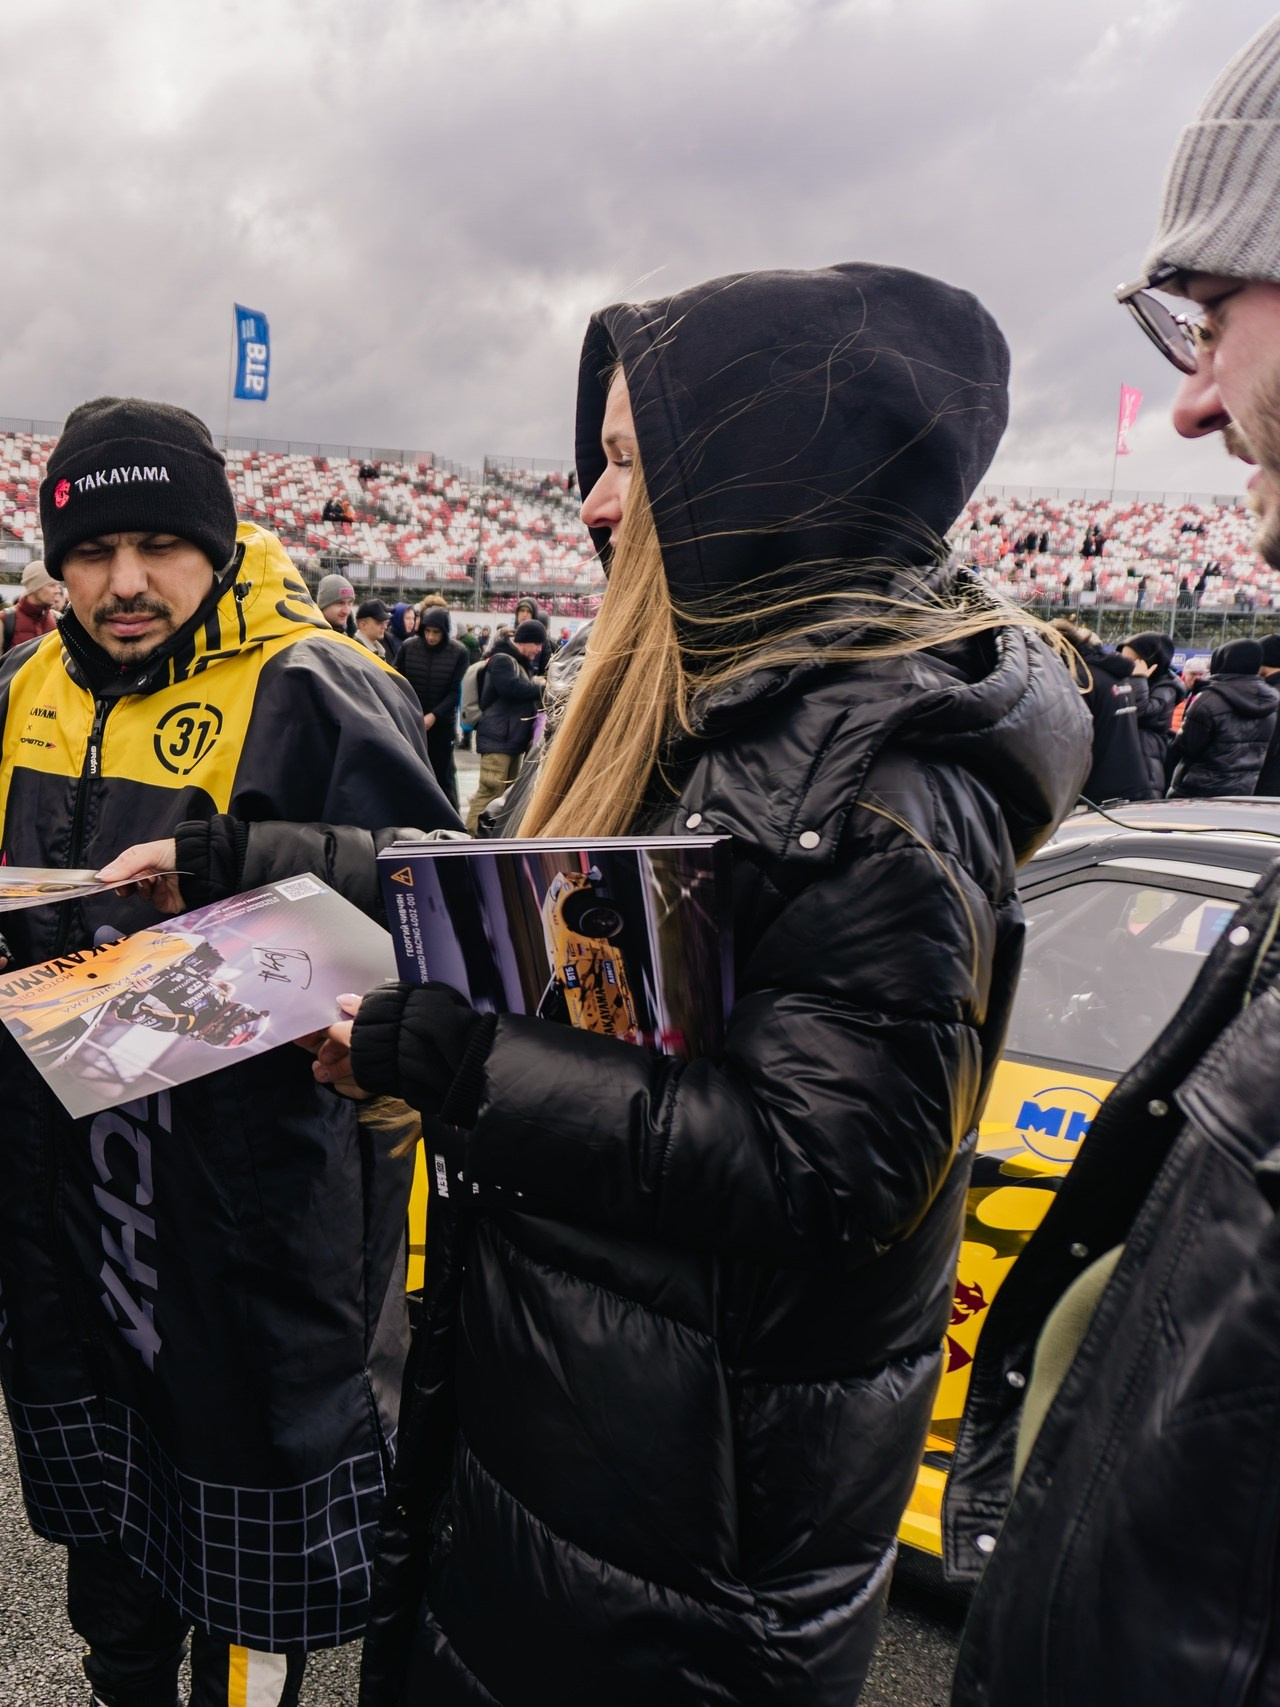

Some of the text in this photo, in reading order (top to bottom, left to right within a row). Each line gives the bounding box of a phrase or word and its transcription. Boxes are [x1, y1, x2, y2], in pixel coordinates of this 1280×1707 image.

[74, 465, 170, 493] TAKAYAMA
[169, 717, 211, 760] 31
[395, 893, 414, 957] ГЕОРГИЙ ЧИВЧЯН
[406, 893, 430, 984] ORWARD RACING 400Z-001
[595, 987, 616, 1034] AKAYAMA
